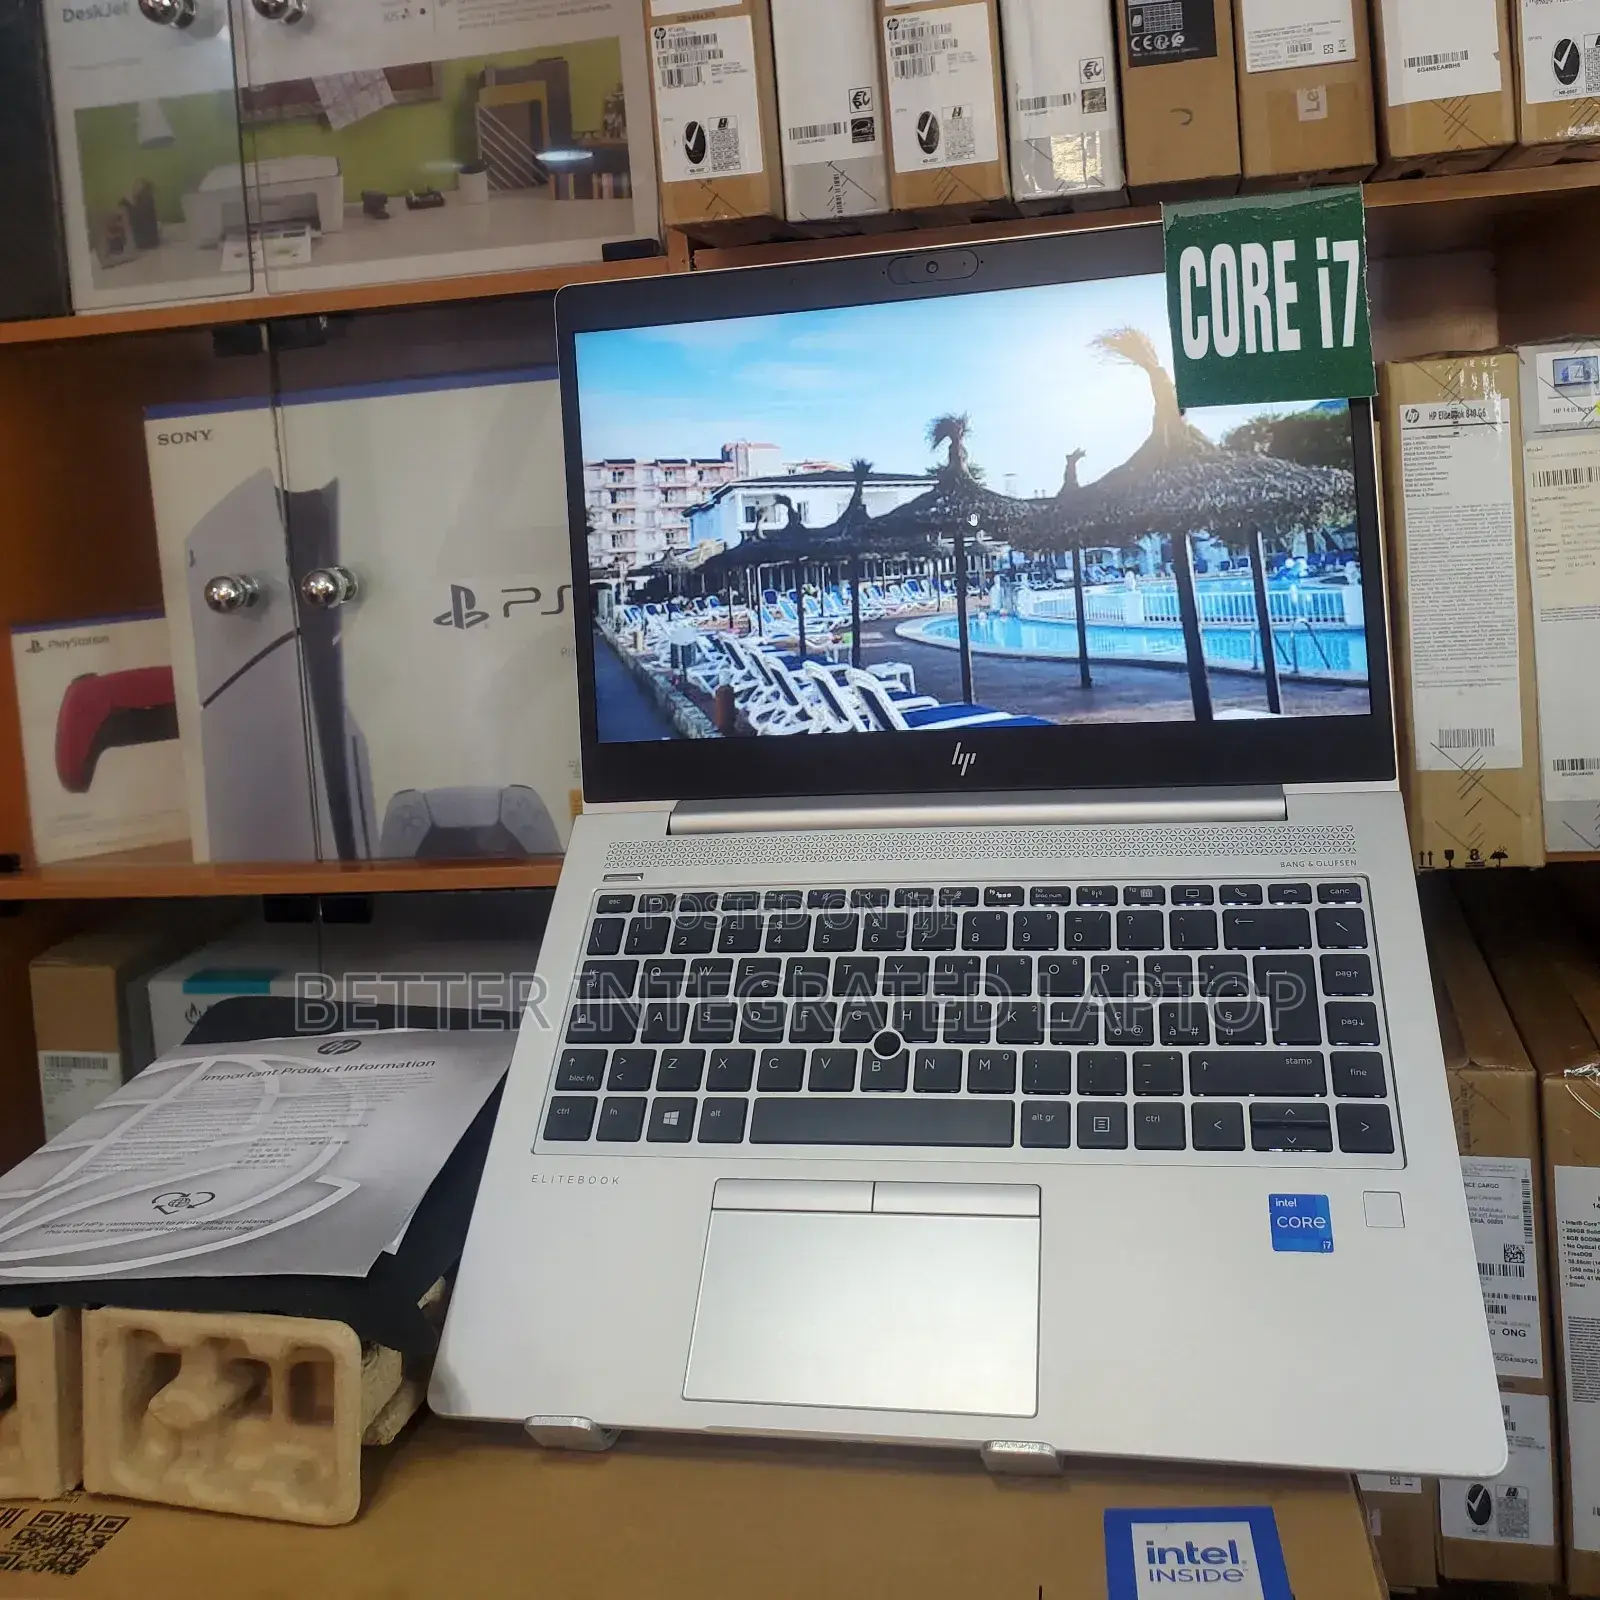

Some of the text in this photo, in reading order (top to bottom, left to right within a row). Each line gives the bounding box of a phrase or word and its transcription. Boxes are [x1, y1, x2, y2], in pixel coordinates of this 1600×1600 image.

[1179, 236, 1360, 360] CORE i7
[1428, 411, 1437, 420] HP
[157, 429, 212, 446] SONY
[48, 635, 110, 650] PlayStation
[1280, 860, 1305, 868] BANG
[995, 913, 1001, 921] 8
[1046, 913, 1052, 921] 9
[1126, 915, 1134, 925] ?
[730, 921, 738, 930] £
[872, 918, 880, 927] &
[679, 936, 688, 946] 2
[726, 935, 734, 945] 3
[773, 935, 782, 944] 4
[822, 934, 830, 944] 5
[871, 933, 879, 943] 6
[971, 932, 980, 942] 8
[1022, 932, 1031, 942] 9
[1019, 958, 1025, 966] 5
[1072, 958, 1078, 966] 6
[650, 966, 661, 977] Q
[699, 966, 714, 976] W
[745, 965, 755, 976] E
[794, 965, 804, 975] R
[843, 964, 852, 975] T
[894, 964, 904, 974] Y
[944, 964, 954, 974] U
[1048, 964, 1060, 974] O
[1100, 964, 1110, 974] P
[1153, 963, 1161, 972] é
[1335, 970, 1352, 978] pag
[761, 979, 770, 988] €
[653, 1012, 663, 1022] A
[702, 1011, 711, 1021] S
[750, 1011, 761, 1021] D
[800, 1011, 809, 1021] F
[852, 1010, 862, 1021] G
[902, 1010, 912, 1021] H
[954, 1010, 962, 1021] J
[1007, 1011, 1017, 1022] K
[1060, 1011, 1070, 1022] L
[1224, 1011, 1233, 1021] §
[1341, 1018, 1357, 1027] pag
[1130, 1024, 1143, 1036] @
[1190, 1026, 1199, 1036] #
[667, 1058, 679, 1069] Z
[717, 1058, 728, 1069] X
[768, 1058, 780, 1069] C
[820, 1058, 832, 1069] V
[871, 1061, 881, 1072] B
[924, 1059, 936, 1070] N
[979, 1059, 991, 1071] M
[1285, 1057, 1312, 1066] stamp
[201, 1059, 436, 1081] Important Product Information
[1350, 1068, 1368, 1077] fine
[568, 1074, 595, 1083] bloc fn
[556, 1107, 570, 1115] ctrl
[609, 1108, 618, 1116] fn
[710, 1109, 721, 1117] alt
[1031, 1113, 1055, 1123] alt gr
[1145, 1115, 1160, 1123] ctrl
[531, 1174, 620, 1185] ELITEBOOK
[1275, 1197, 1297, 1208] intel
[1322, 1240, 1332, 1250] i7
[1502, 1328, 1526, 1337] ONG
[1146, 1539, 1240, 1565] intel
